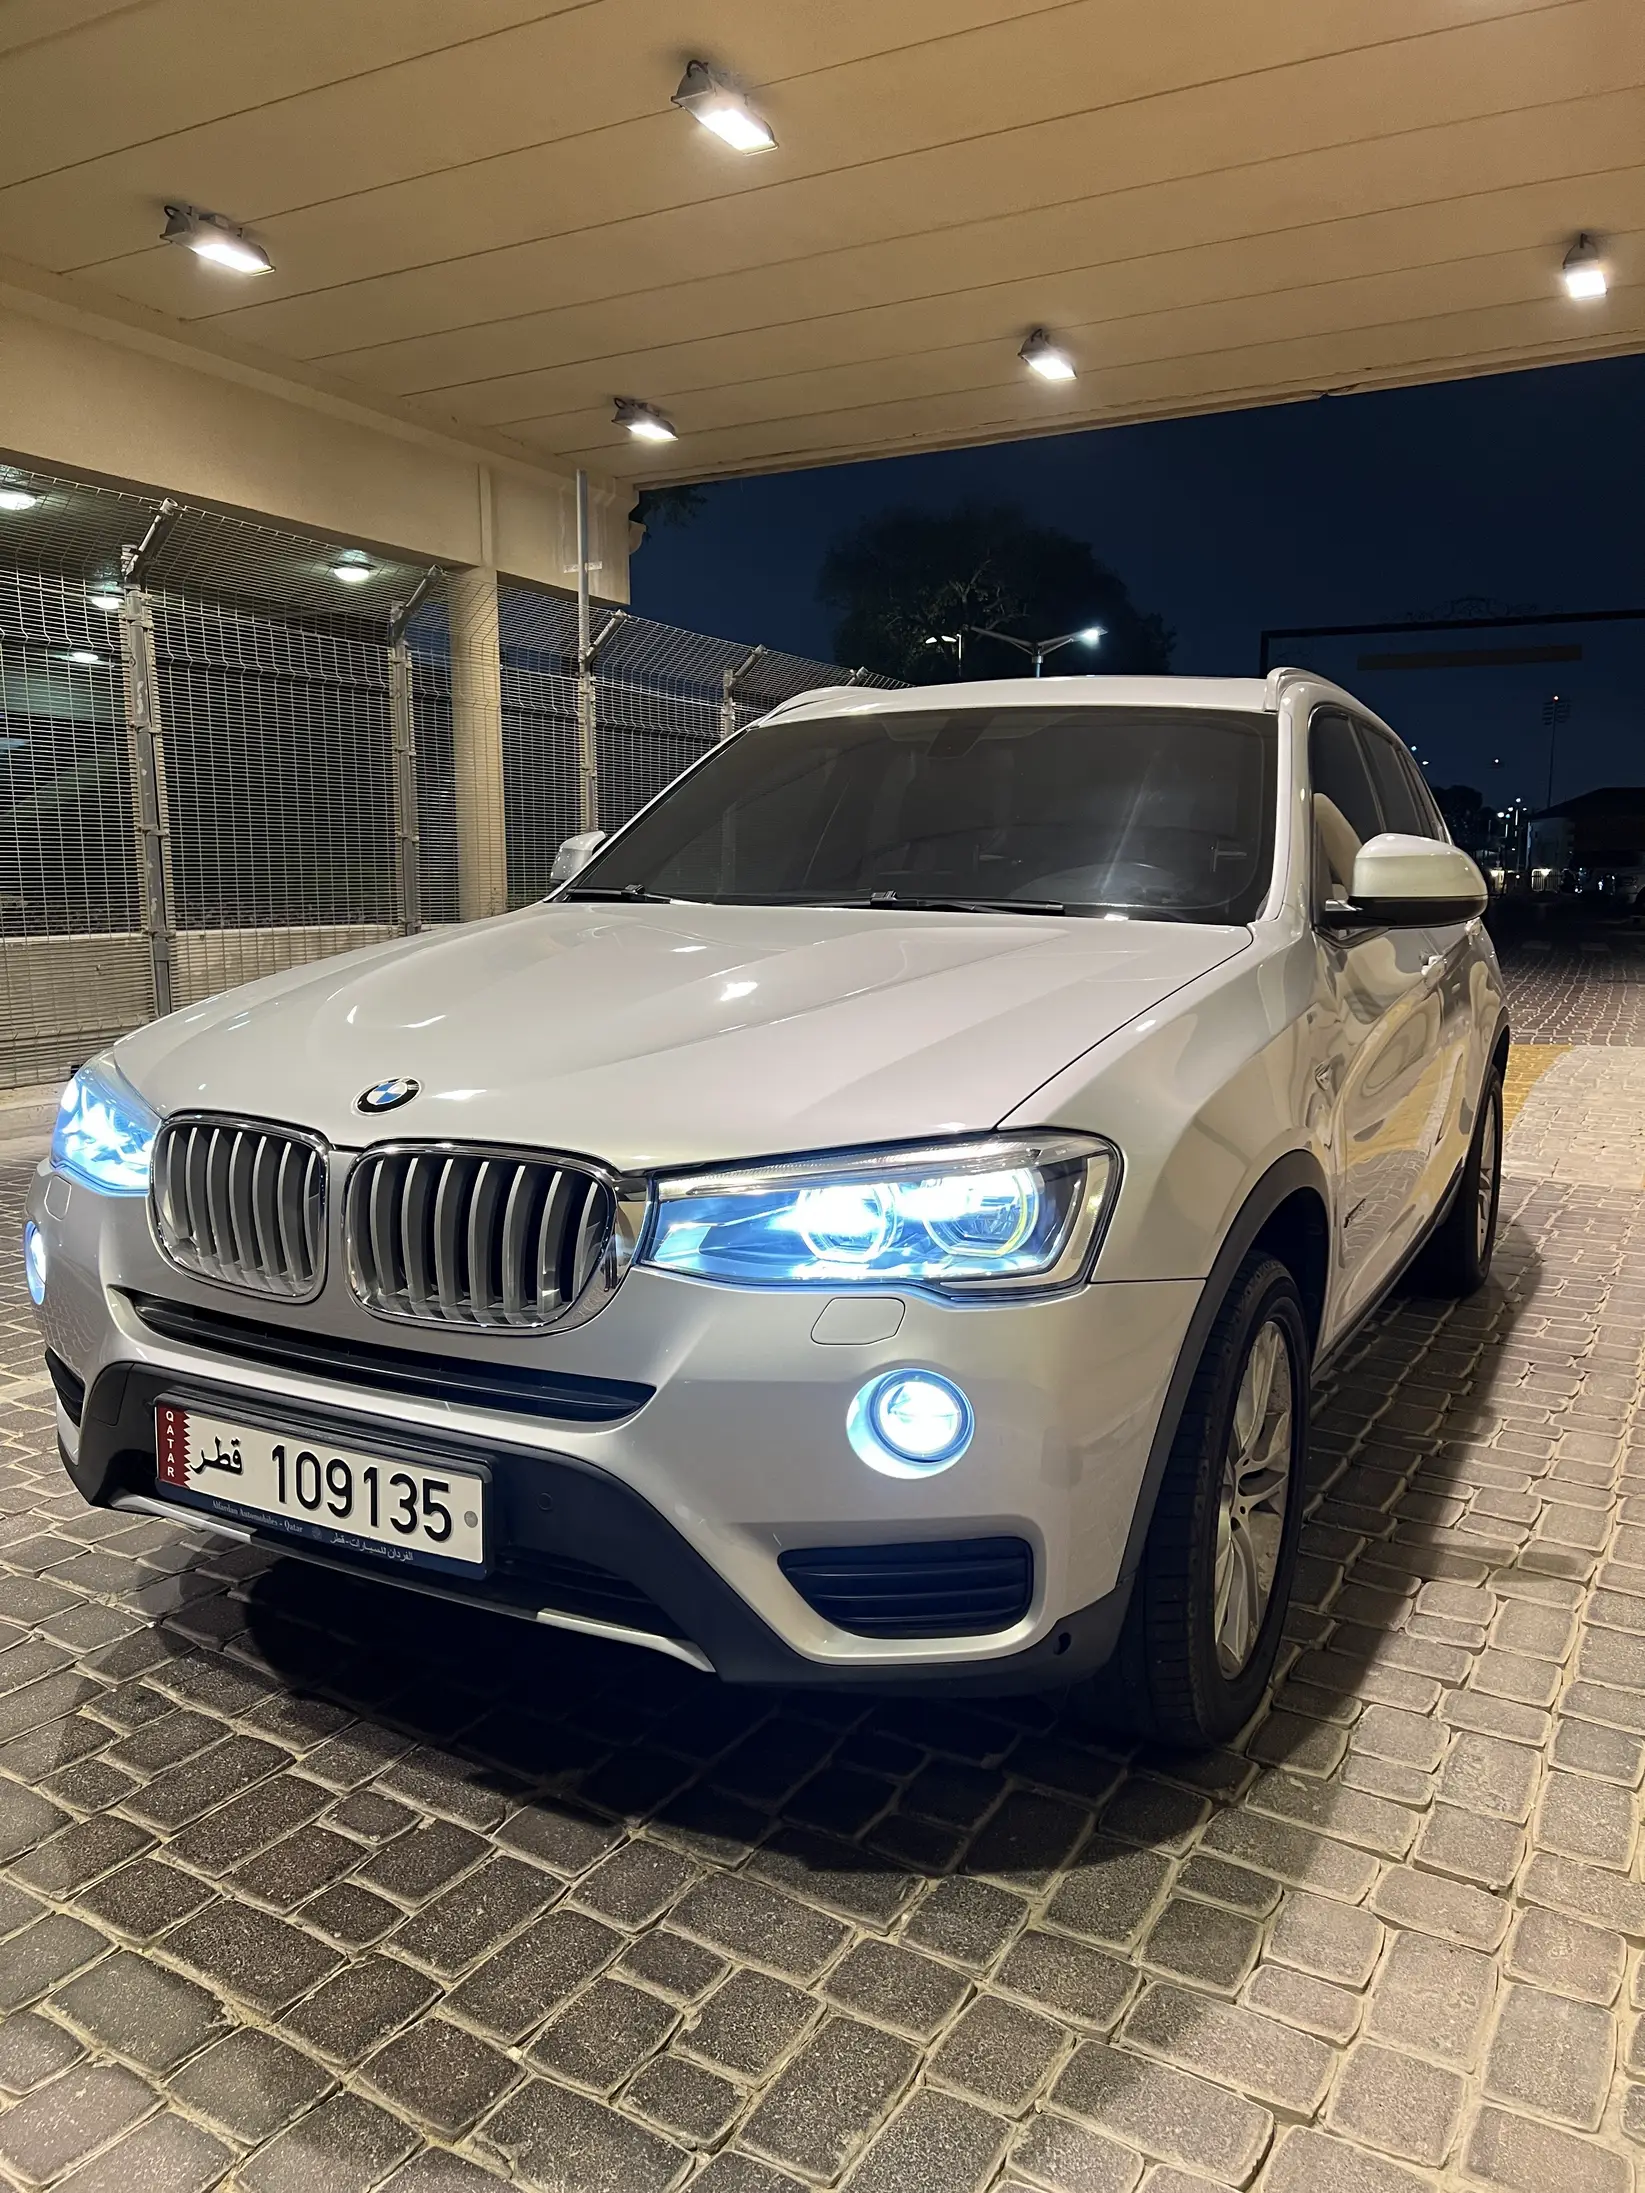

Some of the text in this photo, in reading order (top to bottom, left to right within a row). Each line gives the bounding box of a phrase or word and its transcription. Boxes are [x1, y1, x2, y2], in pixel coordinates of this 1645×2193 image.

[165, 1410, 175, 1478] QATAR
[189, 1435, 243, 1475] قطر
[239, 1508, 278, 1526] Automobiles
[284, 1519, 303, 1532] Qatar
[272, 1444, 453, 1542] 109135
